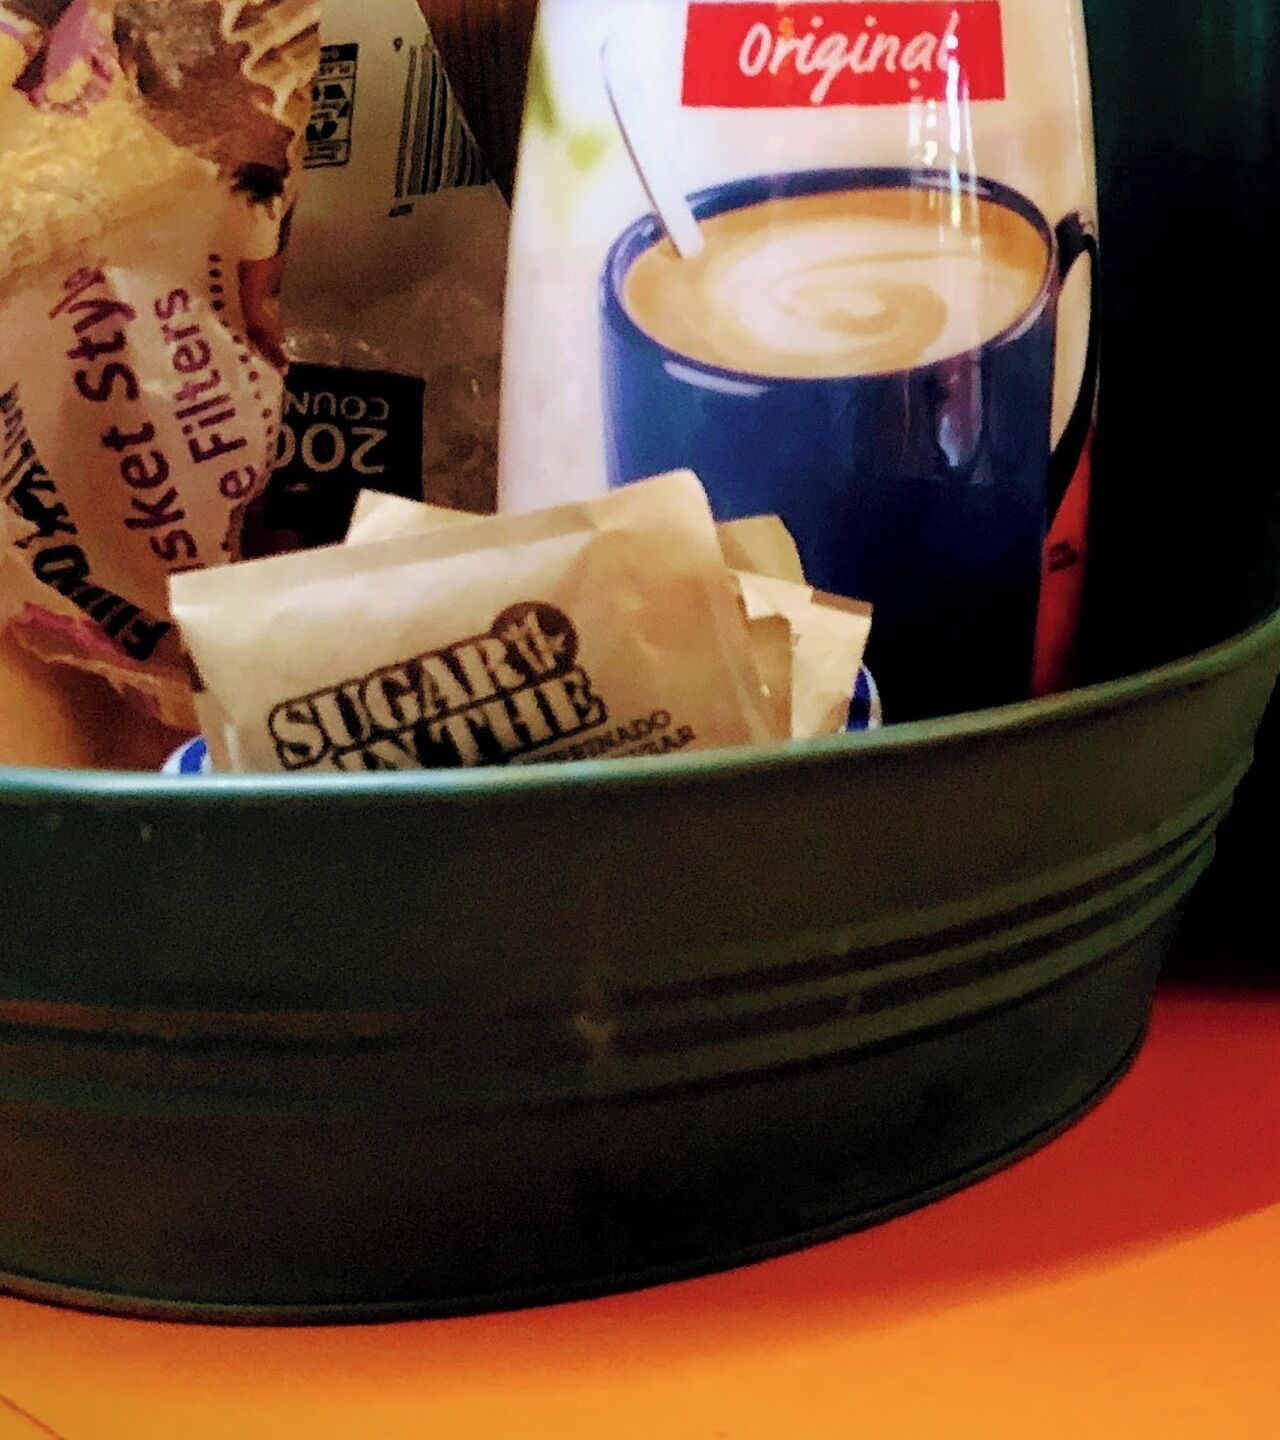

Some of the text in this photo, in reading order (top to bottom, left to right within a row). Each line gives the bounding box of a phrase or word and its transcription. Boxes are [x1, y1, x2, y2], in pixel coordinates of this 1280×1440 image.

[738, 10, 962, 105] Original
[153, 285, 249, 465] Filters
[284, 391, 390, 421] COUN
[101, 420, 205, 574] sket
[269, 634, 529, 768] SUGAR
